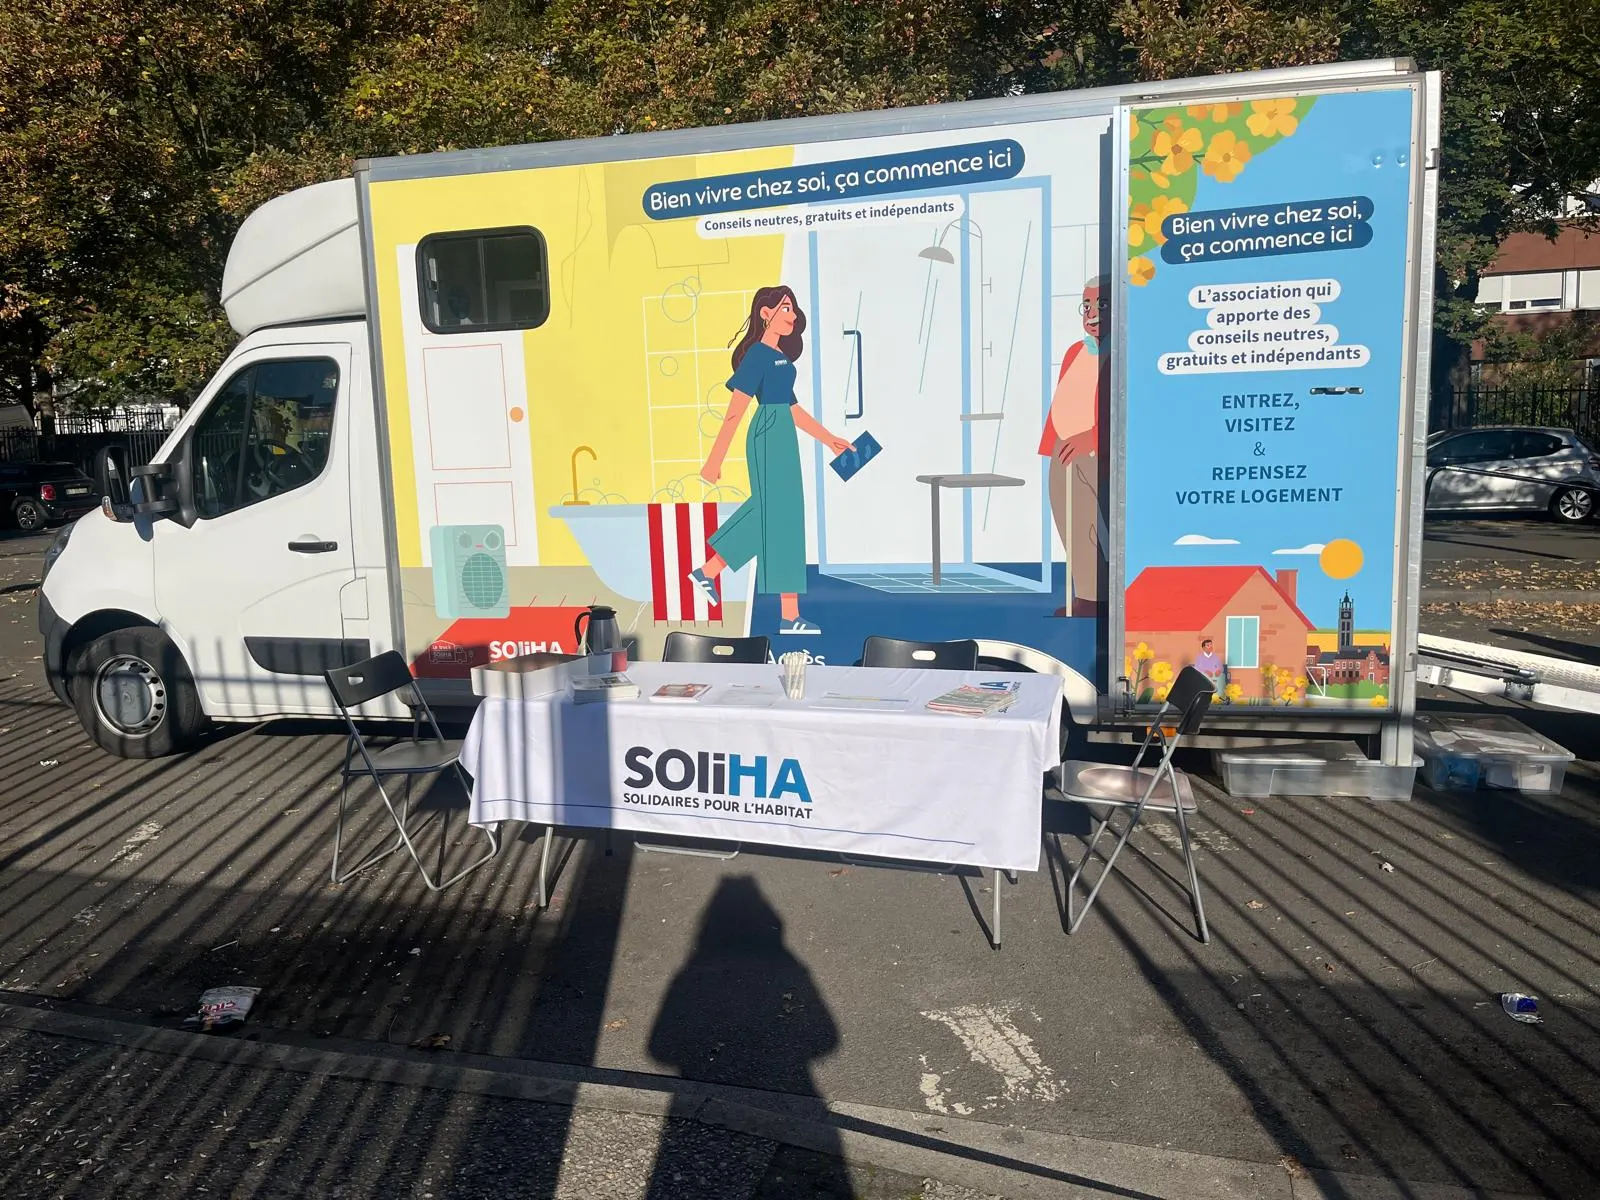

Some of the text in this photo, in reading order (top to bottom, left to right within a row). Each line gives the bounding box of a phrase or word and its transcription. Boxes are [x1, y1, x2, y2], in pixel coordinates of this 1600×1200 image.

[651, 147, 1012, 211] Bien vivre chez soi, ça commence ici
[704, 200, 955, 232] Conseils neutres, gratuits et indépendants
[1172, 200, 1362, 235] Bien vivre chez soi,
[1180, 225, 1353, 262] ça commence ici
[1305, 282, 1332, 300] qui
[1216, 306, 1311, 326] apporte des
[1197, 328, 1330, 345] conseils neutres,
[1166, 346, 1361, 370] gratuits et indépendants
[1222, 392, 1300, 411] ENTREZ,
[1225, 417, 1295, 433] VISITEZ
[1253, 441, 1266, 457] &
[1212, 465, 1307, 481] REPENSEZ
[1175, 487, 1343, 505] VOTRE LOGEMENT
[623, 793, 699, 808] SOLIDAIRES
[704, 799, 740, 813] POUR
